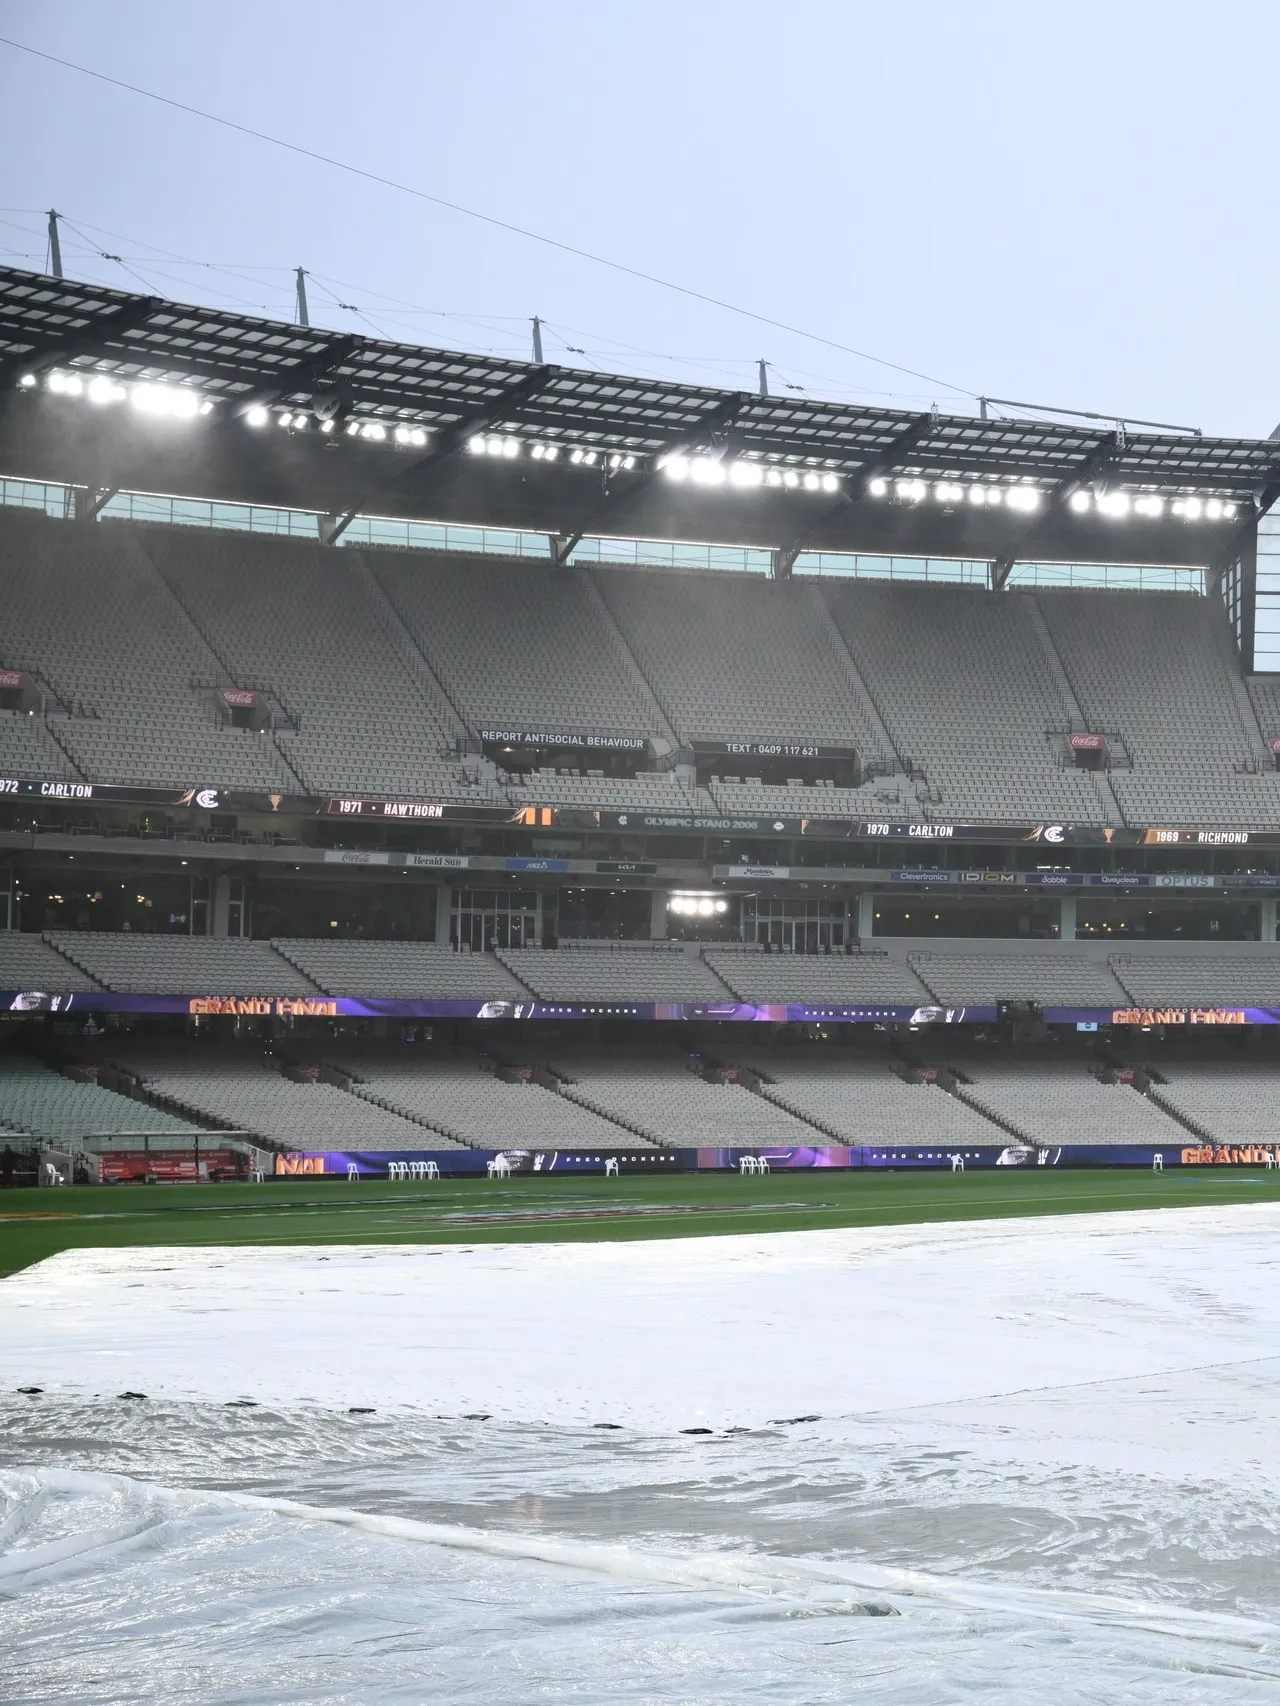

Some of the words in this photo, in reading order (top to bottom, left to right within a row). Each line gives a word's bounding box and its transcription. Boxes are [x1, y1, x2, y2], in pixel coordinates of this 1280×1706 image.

[482, 730, 523, 742] REPORT
[525, 733, 585, 745] ANTISOCIAL
[587, 736, 644, 748] BEHAVIOUR
[1072, 737, 1098, 746] Coca-Cola
[726, 743, 752, 753] TEXT
[758, 744, 782, 754] 0409
[785, 746, 800, 755] 117
[802, 746, 819, 756] 621
[41, 782, 93, 798] CARLTON
[339, 801, 362, 813] 1971
[384, 803, 443, 817] HAWTHORN
[644, 816, 691, 827] OLYMPIC
[694, 818, 731, 829] STAND
[867, 824, 889, 835] 1970
[908, 825, 954, 837] CARLTON
[1156, 831, 1179, 842] 1969
[1198, 831, 1248, 843] RICHMOND
[414, 856, 442, 866] Herald
[444, 858, 461, 867] Sun
[900, 872, 948, 881] Clevertronics
[961, 873, 1015, 882] IDIOM
[1161, 876, 1209, 886] OPTUS
[190, 999, 271, 1014] GRAND
[276, 1001, 341, 1016] FINAL
[1112, 1010, 1186, 1024] GRAND
[1190, 1011, 1249, 1024] FINAL
[1181, 1148, 1268, 1164] GRAND
